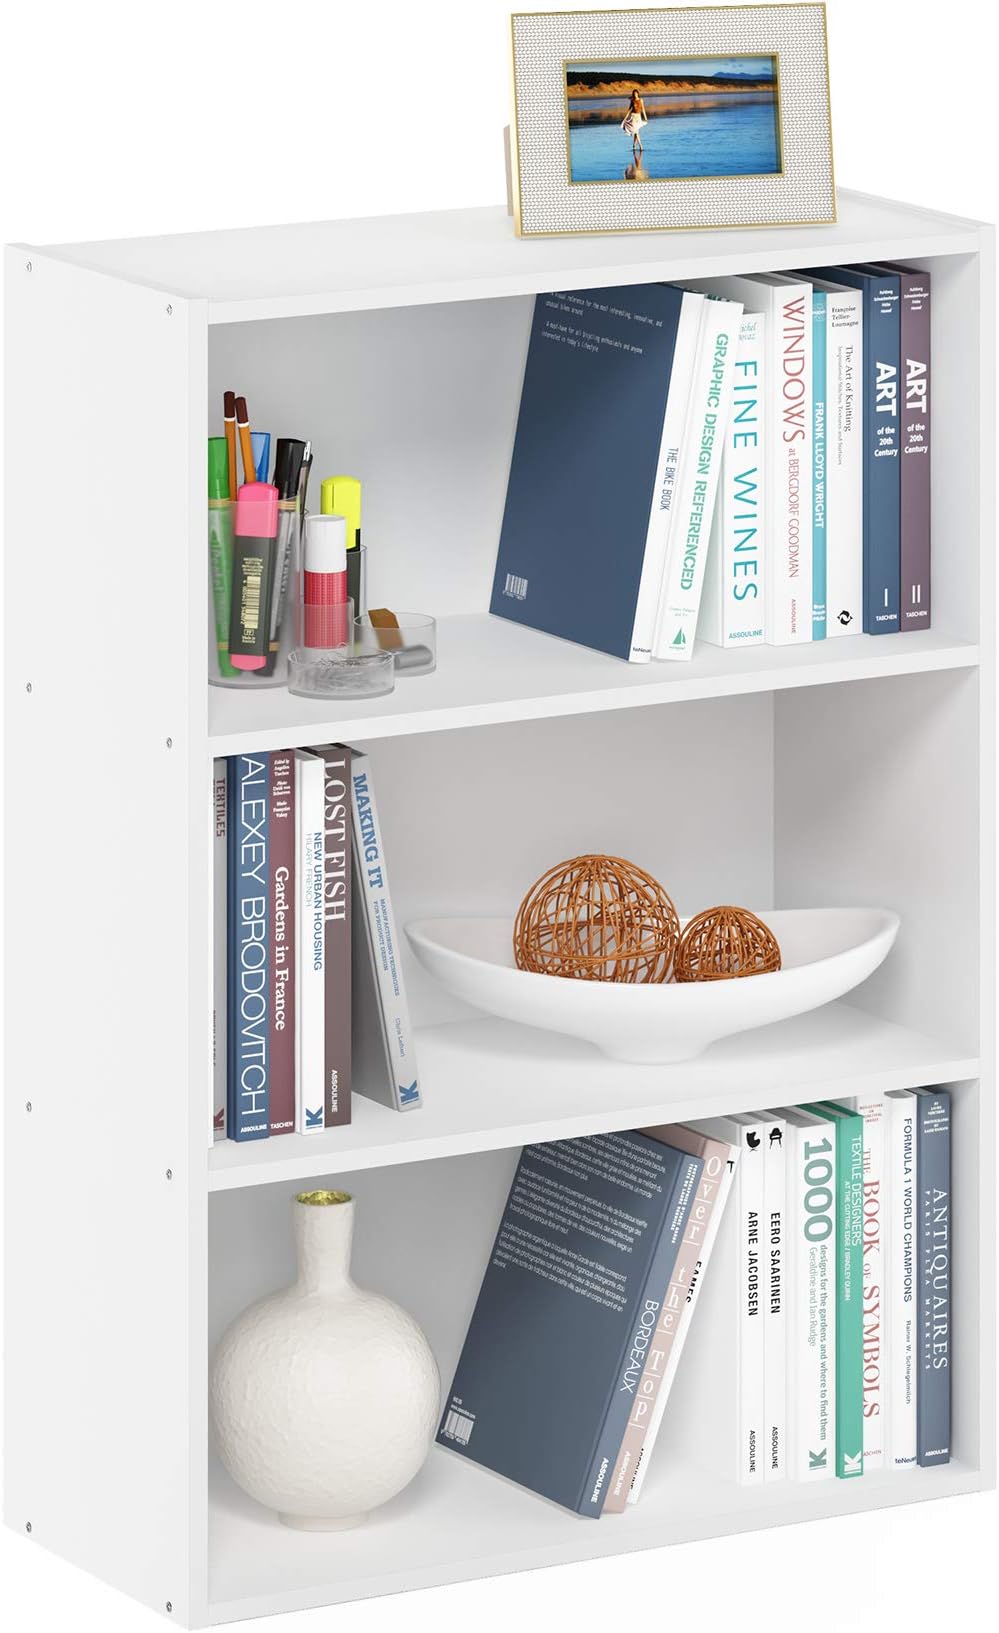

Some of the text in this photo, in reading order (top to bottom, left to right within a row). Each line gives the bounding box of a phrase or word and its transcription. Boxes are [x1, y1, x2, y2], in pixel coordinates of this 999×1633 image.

[707, 333, 729, 409] GRAPHIC
[843, 345, 854, 432] The Art of Knitting
[876, 362, 897, 416] ART
[906, 358, 927, 414] ART
[697, 413, 717, 476] DESIGN
[783, 296, 805, 579] WINDOWS at BERGDORF GOODMAN
[874, 448, 898, 457] Century
[877, 426, 895, 436] of the
[879, 437, 894, 446] 20th
[904, 445, 928, 454] Century
[907, 423, 926, 432] of the
[909, 433, 924, 443] 20th
[659, 448, 679, 511] THE BIKE BOOK
[733, 361, 758, 601] FINE WINES
[815, 402, 825, 529] FRANK LLOYD WRIGHT
[680, 480, 708, 591] REFERENCED
[875, 614, 898, 622] TASCHEN
[905, 610, 928, 618] TASCHEN
[912, 584, 921, 604] II
[728, 629, 763, 640] ASSOULINE
[216, 777, 226, 838] TEXTILES
[353, 773, 384, 889] MAKING IT
[324, 758, 347, 921] LOST FISH
[305, 868, 313, 908] FRENCH
[313, 832, 323, 971] NEW URBAN HOUSING
[241, 756, 266, 1115] ALEXEY BRODOVITCH
[275, 866, 289, 1031] Gardens in France
[240, 1124, 268, 1133] ASSOULINE
[270, 1121, 294, 1130] TASCHEN
[903, 1118, 913, 1175] FORMULA
[851, 1134, 862, 1247] TEXTILE DESIGNERS
[903, 1187, 913, 1230] WORLD
[635, 1156, 722, 1423] Over the Top
[748, 1211, 759, 1316] ARNE JACOBSEN
[770, 1212, 781, 1314] EERO SAARINEN
[803, 1137, 833, 1441] 1000 designs for the gardens and where to find them
[809, 1246, 818, 1287] Geraldine
[863, 1148, 881, 1418] THE BOOK OF SYMBOLS
[903, 1232, 913, 1303] CHAMPIONS
[929, 1188, 948, 1369] ANTIQUAIRES
[809, 1288, 818, 1304] and
[620, 1299, 660, 1394] BORDEAUX
[807, 1319, 818, 1347] Rudge
[613, 1451, 632, 1496] ASSOULINE
[771, 1426, 779, 1470] ASSOULINE
[925, 1448, 948, 1457] ASSOULINE
[590, 1457, 610, 1504] ASSOULINE
